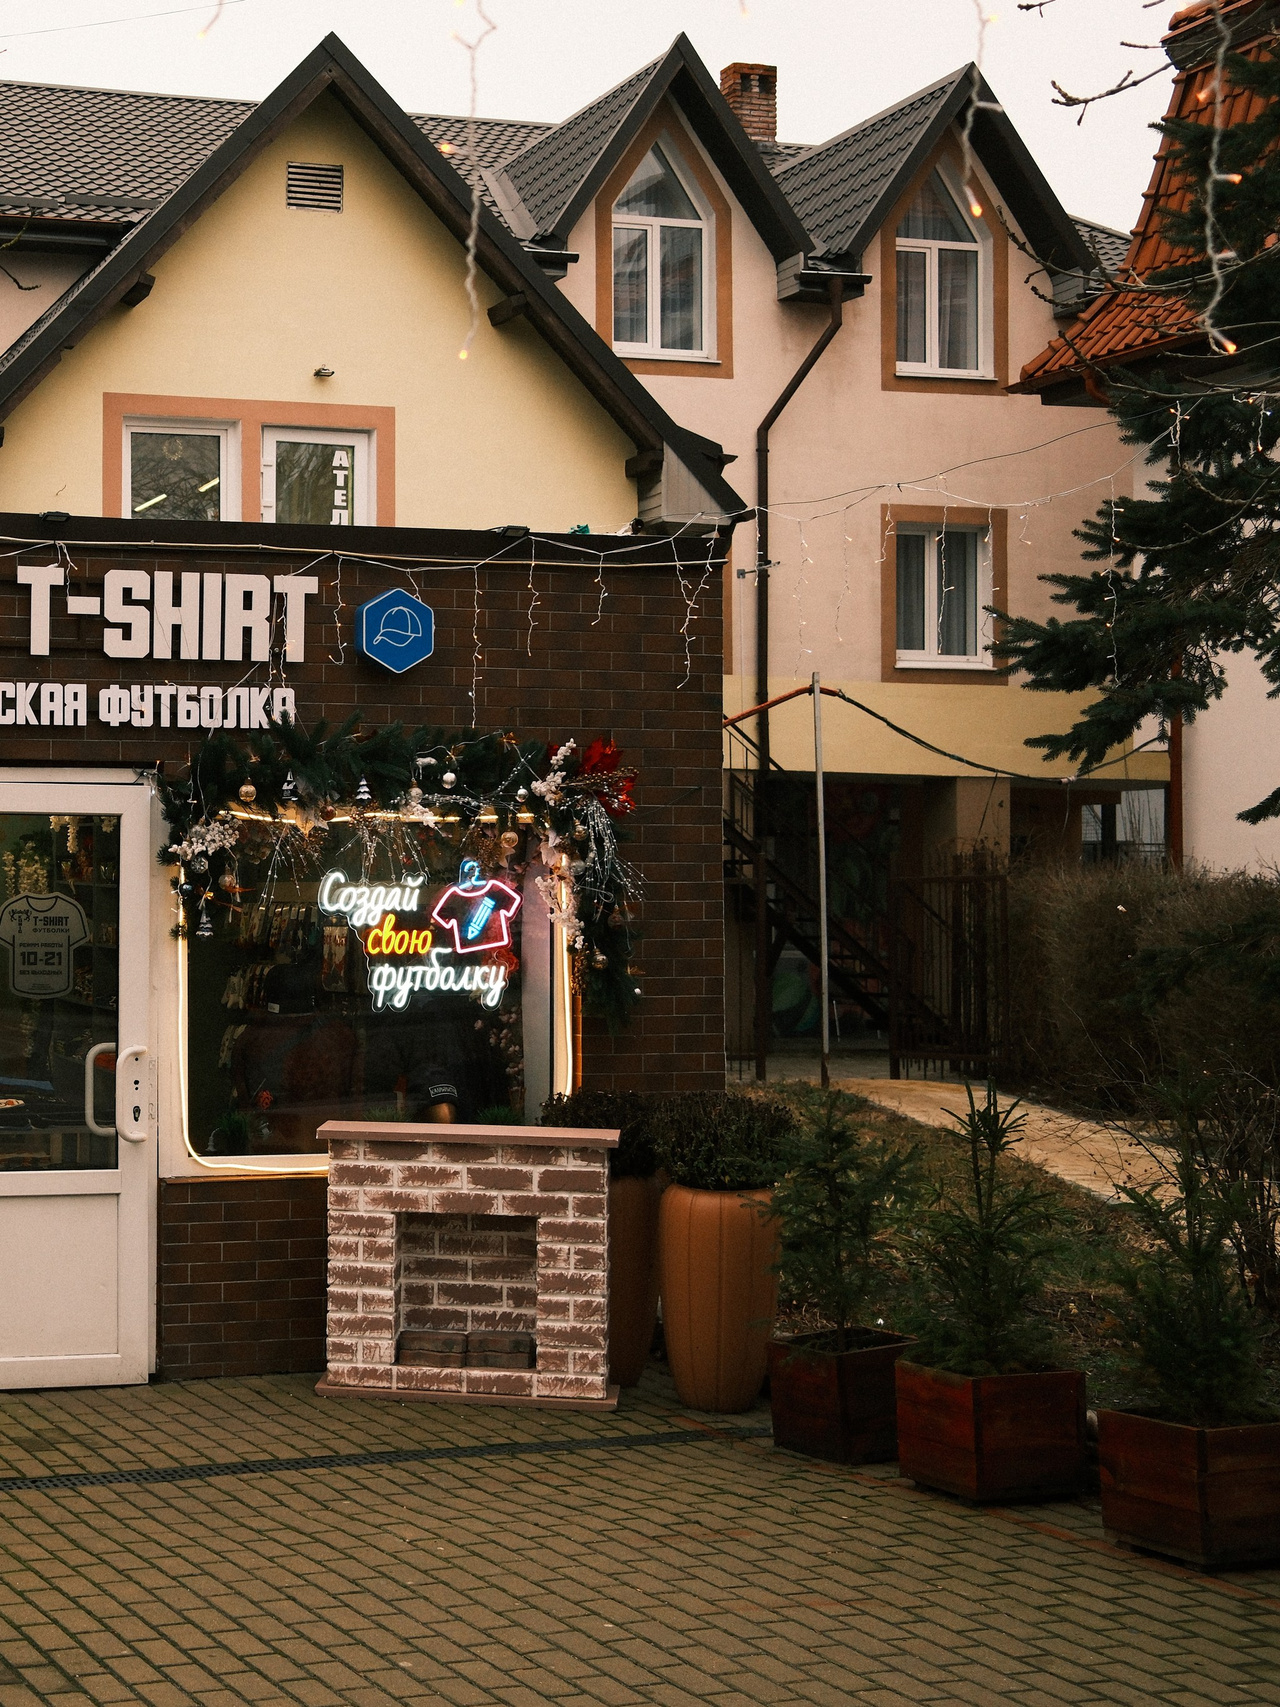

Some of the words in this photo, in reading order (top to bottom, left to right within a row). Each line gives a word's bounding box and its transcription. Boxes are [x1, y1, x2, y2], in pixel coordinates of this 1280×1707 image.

[16, 565, 319, 663] T-SHIRT
[98, 683, 296, 729] ФУТБОЛКА
[33, 916, 69, 926] T-SHIRT
[323, 872, 424, 927] Создай
[367, 914, 433, 954] свою
[372, 947, 506, 1008] футболку
